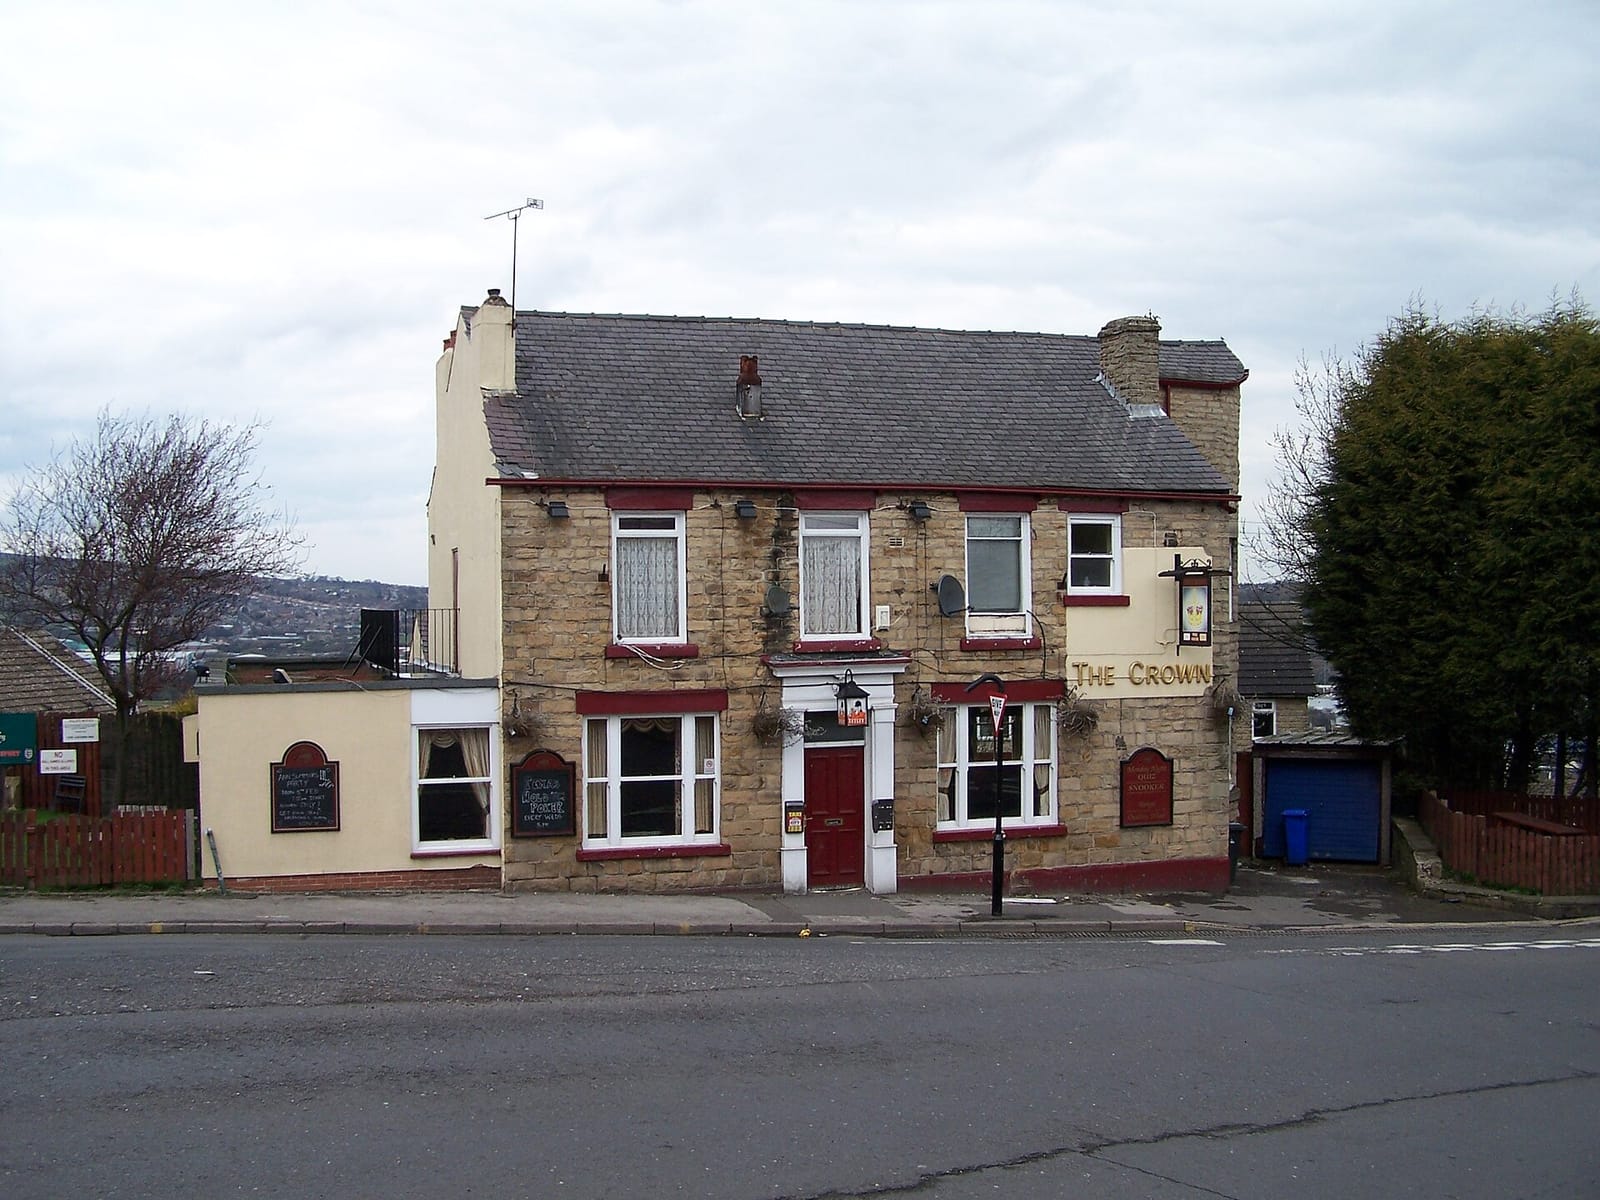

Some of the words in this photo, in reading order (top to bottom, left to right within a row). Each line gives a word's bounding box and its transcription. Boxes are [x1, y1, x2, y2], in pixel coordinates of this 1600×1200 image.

[1072, 661, 1115, 686] THE
[1128, 660, 1210, 685] CROWN
[1137, 772, 1156, 780] QUIZ
[1128, 783, 1165, 791] SNOOKER
[530, 801, 565, 814] POKER
